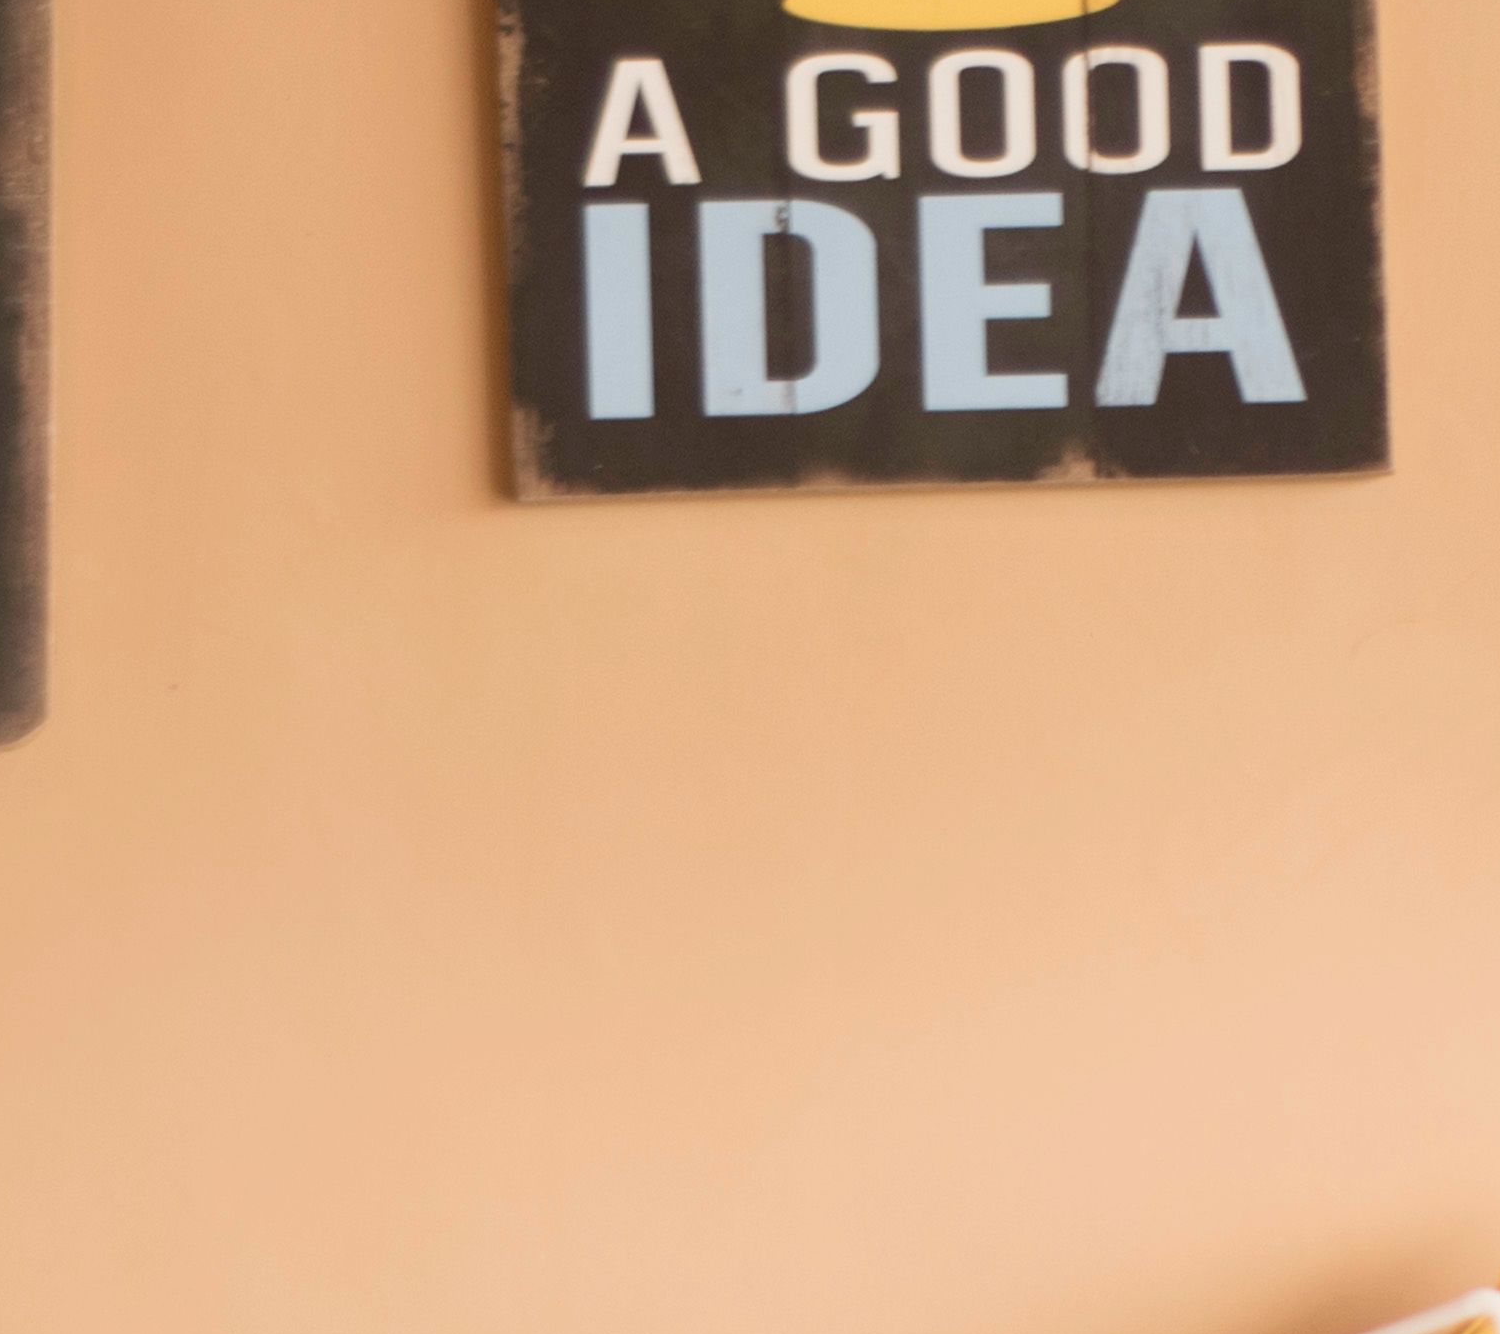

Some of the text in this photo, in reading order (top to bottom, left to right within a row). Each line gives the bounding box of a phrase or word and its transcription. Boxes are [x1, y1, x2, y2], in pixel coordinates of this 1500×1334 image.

[583, 43, 1302, 188] A GOOD
[583, 186, 1307, 421] IDEA
